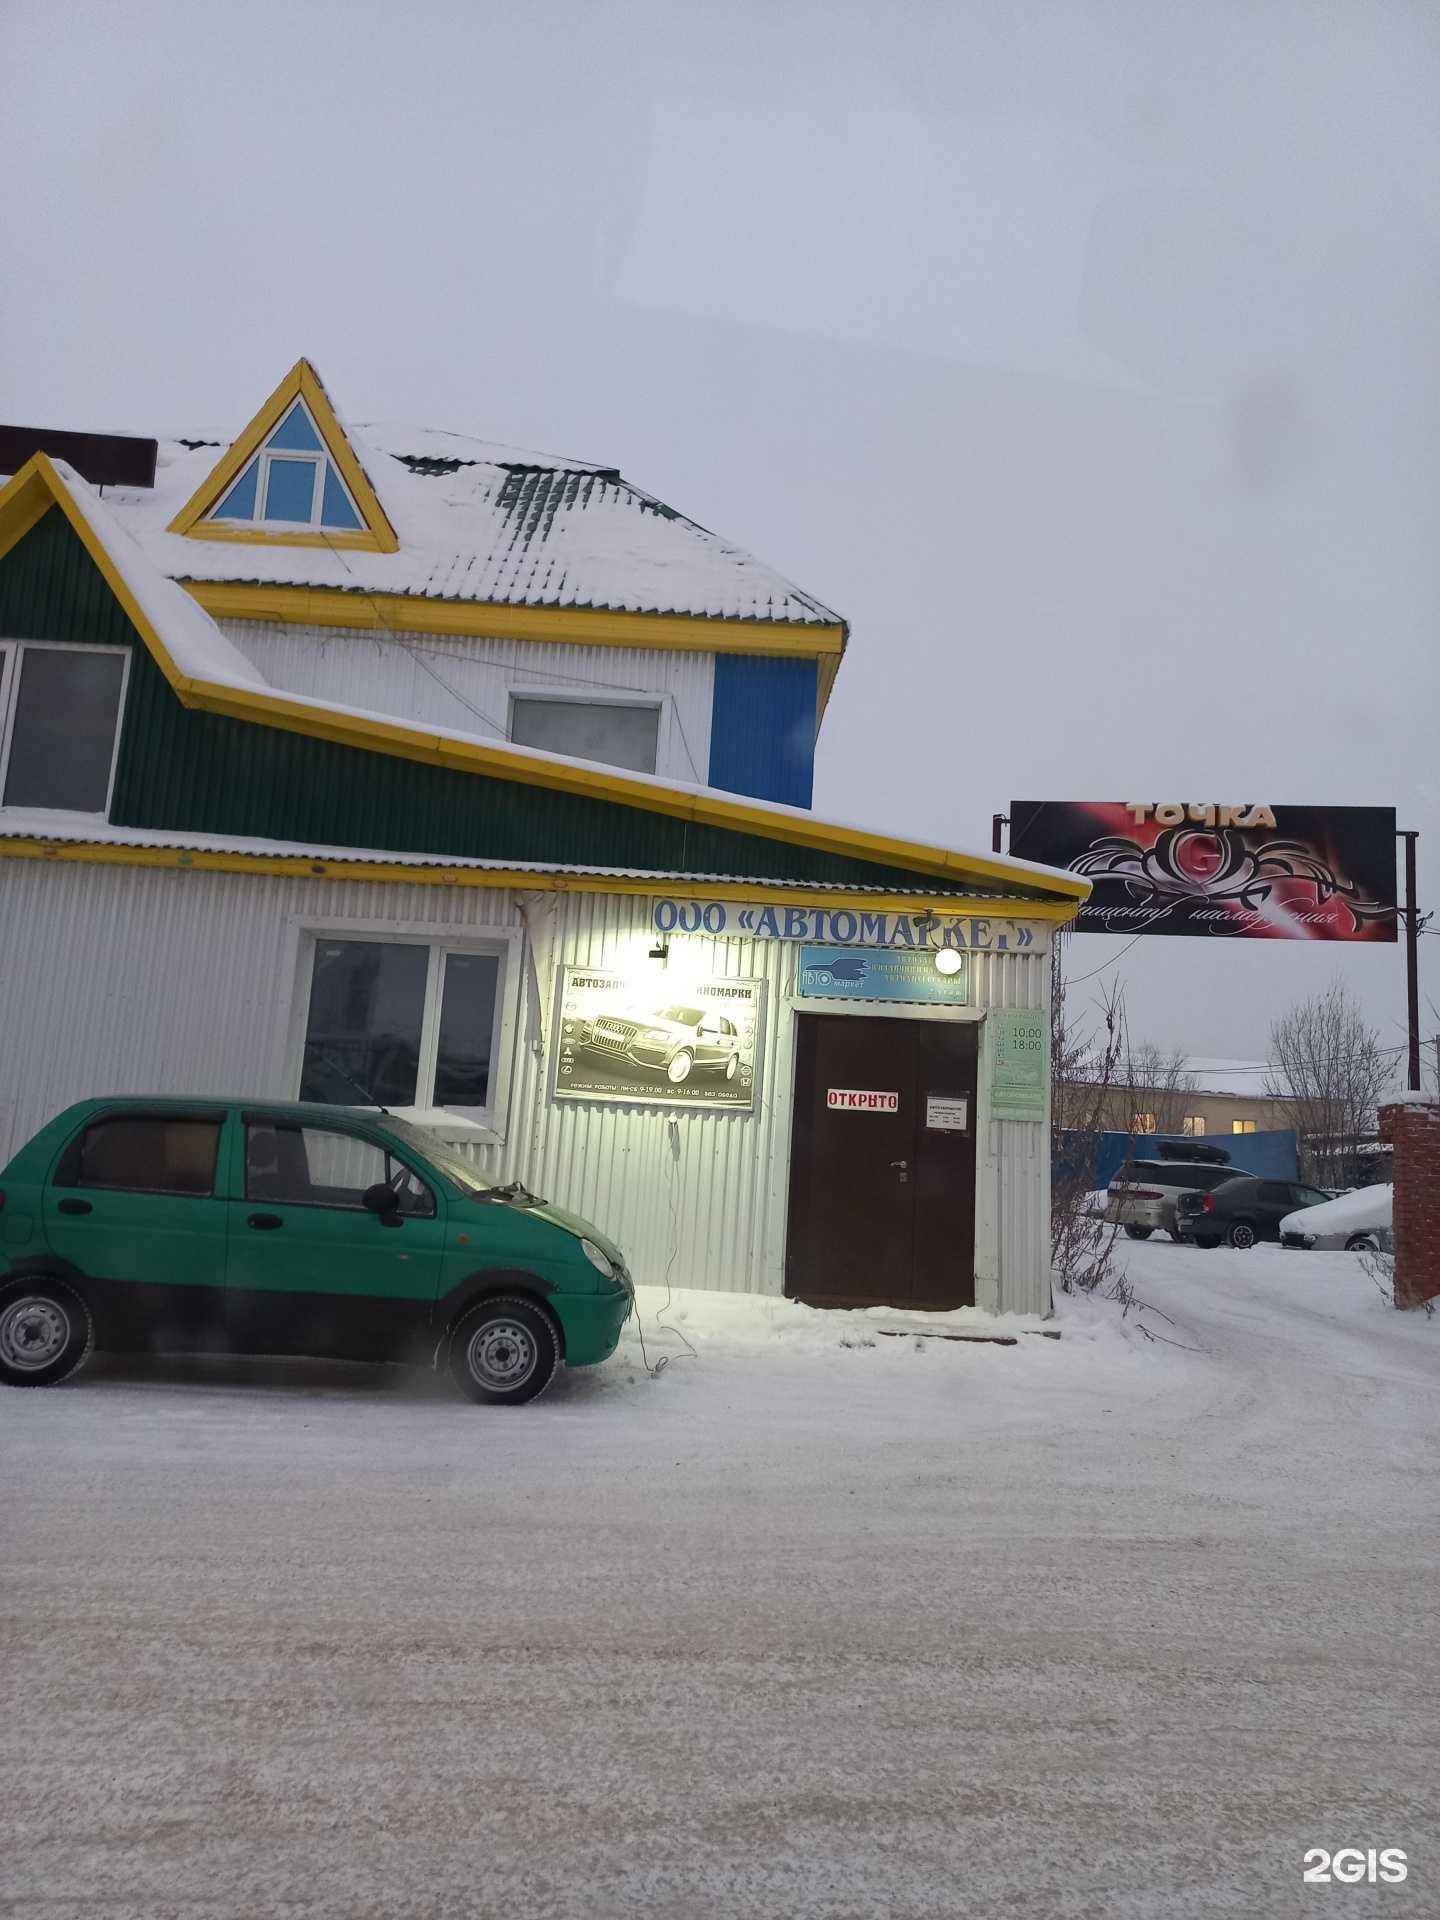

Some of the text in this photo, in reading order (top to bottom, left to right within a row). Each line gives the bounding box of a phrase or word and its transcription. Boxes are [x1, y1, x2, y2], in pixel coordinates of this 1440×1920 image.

[1125, 801, 1278, 827] ТОЧКА
[654, 900, 726, 934] ООО
[828, 1092, 898, 1109] ОТКРЫТО
